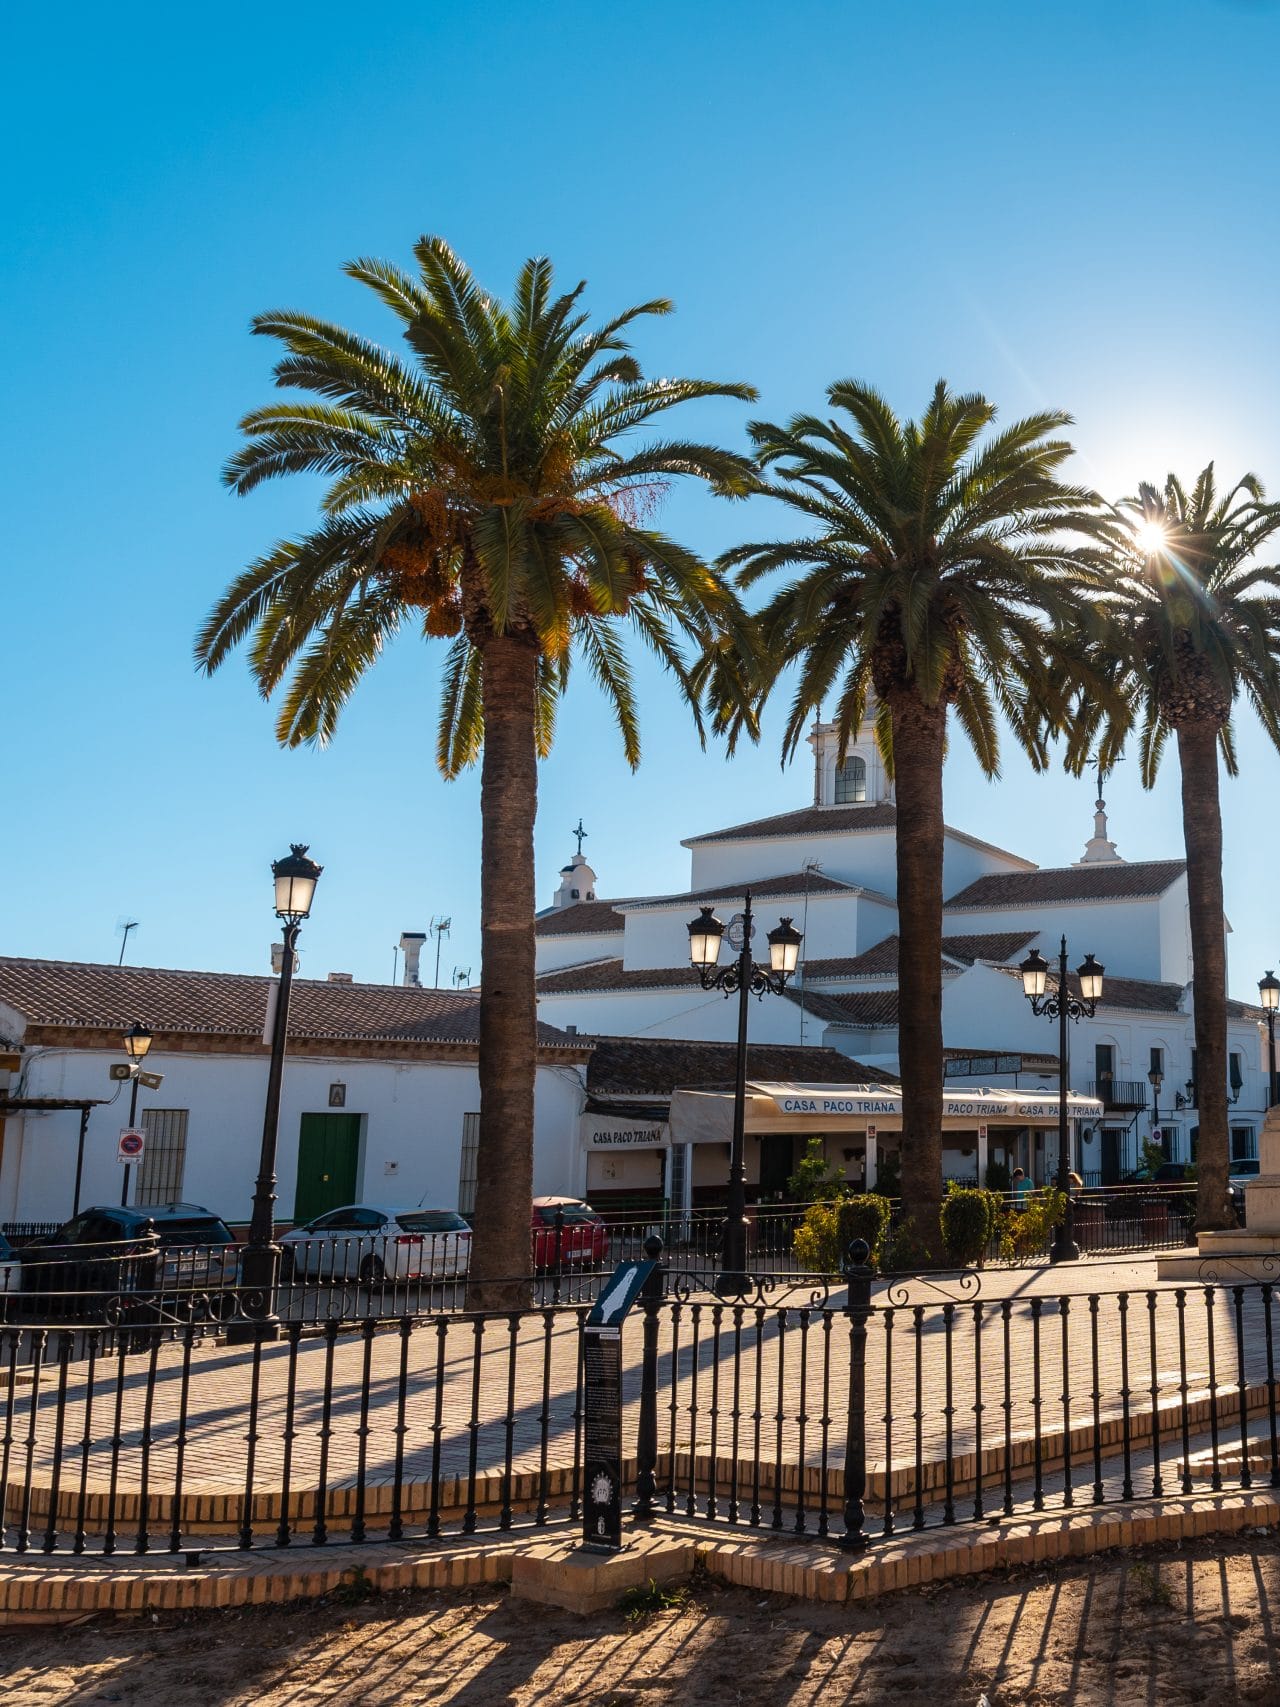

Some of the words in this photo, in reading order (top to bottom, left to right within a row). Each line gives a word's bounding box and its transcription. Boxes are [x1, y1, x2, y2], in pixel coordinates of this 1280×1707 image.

[784, 1100, 816, 1111] CASA
[823, 1101, 853, 1112] PACO
[856, 1101, 896, 1112] TRIANA
[947, 1103, 973, 1114] PACO
[976, 1103, 1008, 1115] TRIANA
[1019, 1105, 1044, 1115] CASA
[1048, 1106, 1070, 1115] PA
[1072, 1106, 1100, 1116] TRIANA
[593, 1131, 612, 1144] CASA
[613, 1131, 633, 1143] PACO
[633, 1129, 661, 1142] TRIANA
